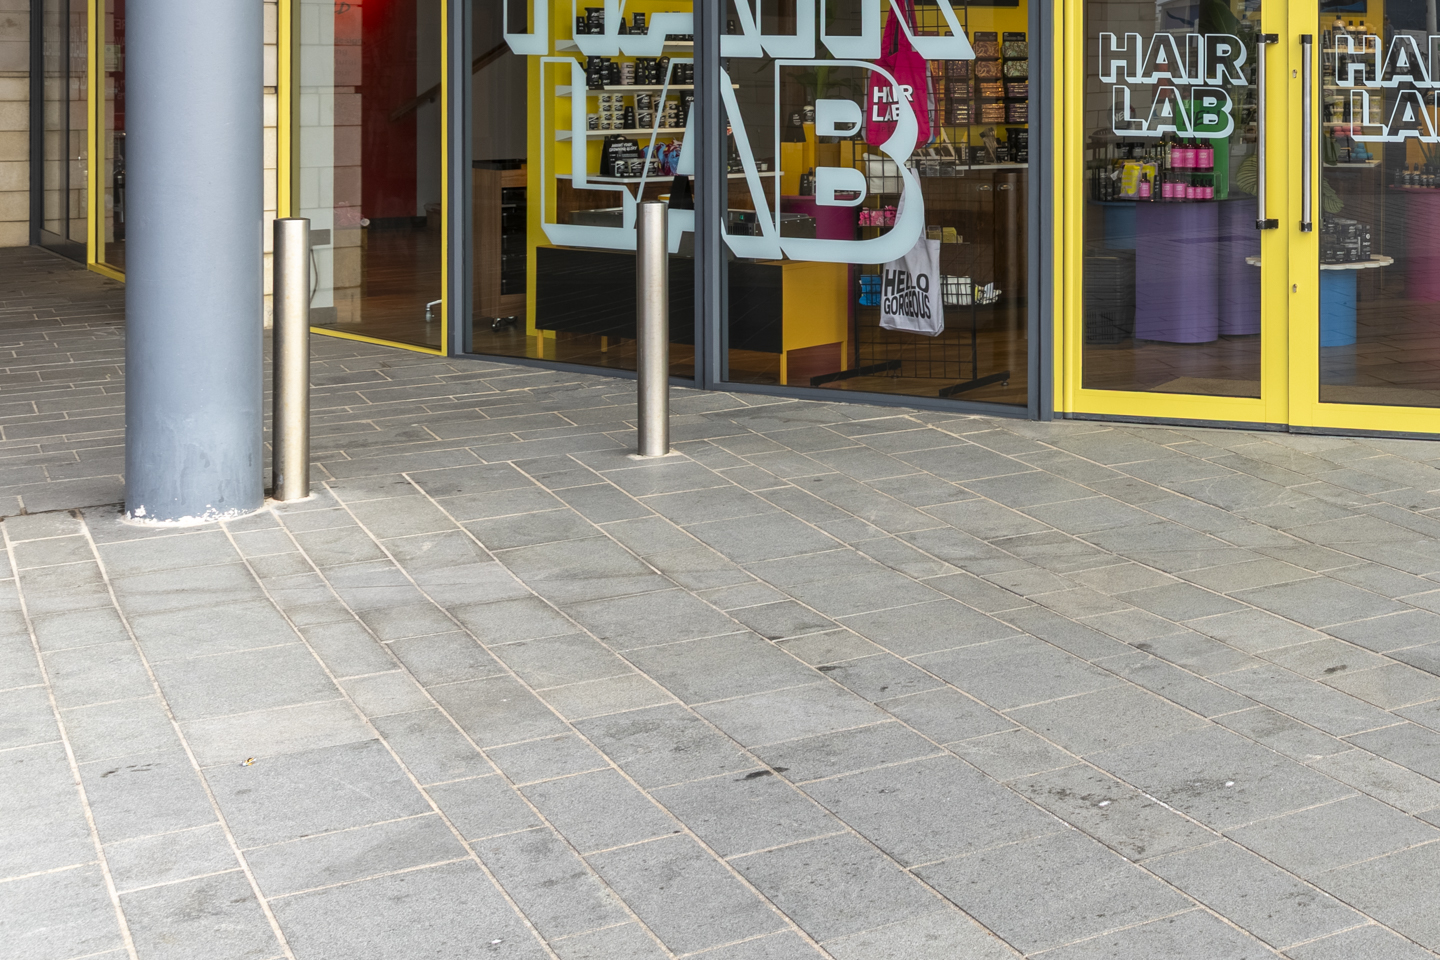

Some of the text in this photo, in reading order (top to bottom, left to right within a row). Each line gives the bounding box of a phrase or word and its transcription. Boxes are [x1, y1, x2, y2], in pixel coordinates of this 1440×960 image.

[1098, 32, 1248, 87] HAIR
[1112, 85, 1235, 139] LAB
[539, 56, 925, 265] LAB
[883, 290, 932, 320] GORGEOUS
